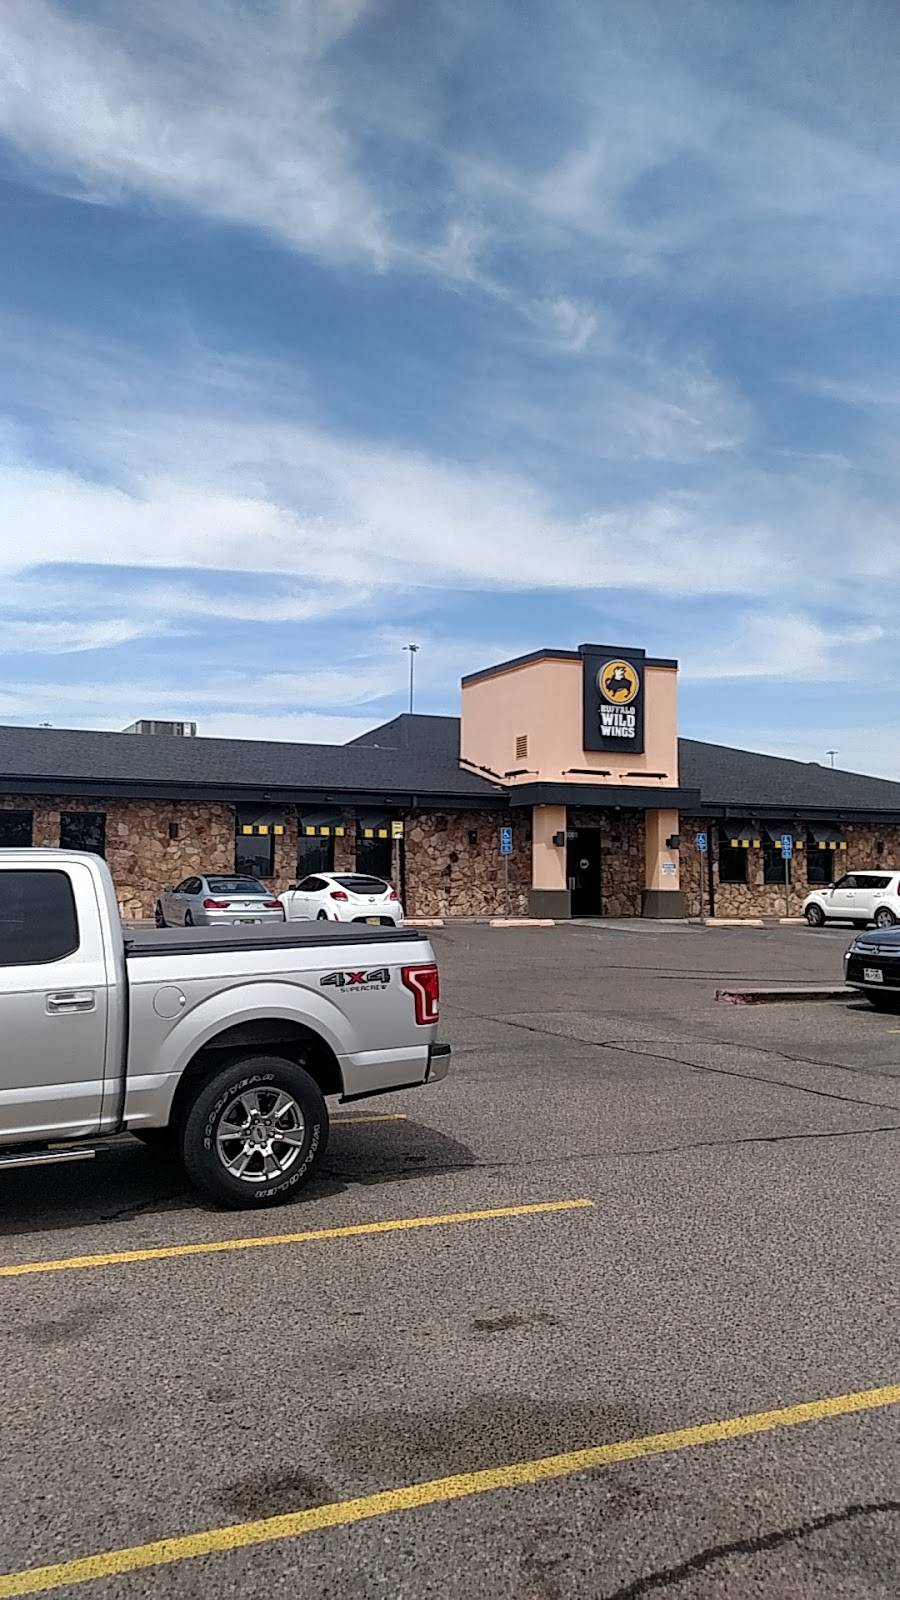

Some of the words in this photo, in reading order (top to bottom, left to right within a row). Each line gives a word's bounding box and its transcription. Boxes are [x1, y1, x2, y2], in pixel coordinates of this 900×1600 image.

[600, 704, 635, 714] BUFFALO
[601, 713, 635, 727] WILD
[600, 725, 635, 738] WINGS
[203, 1073, 275, 1150] GOODYEAR
